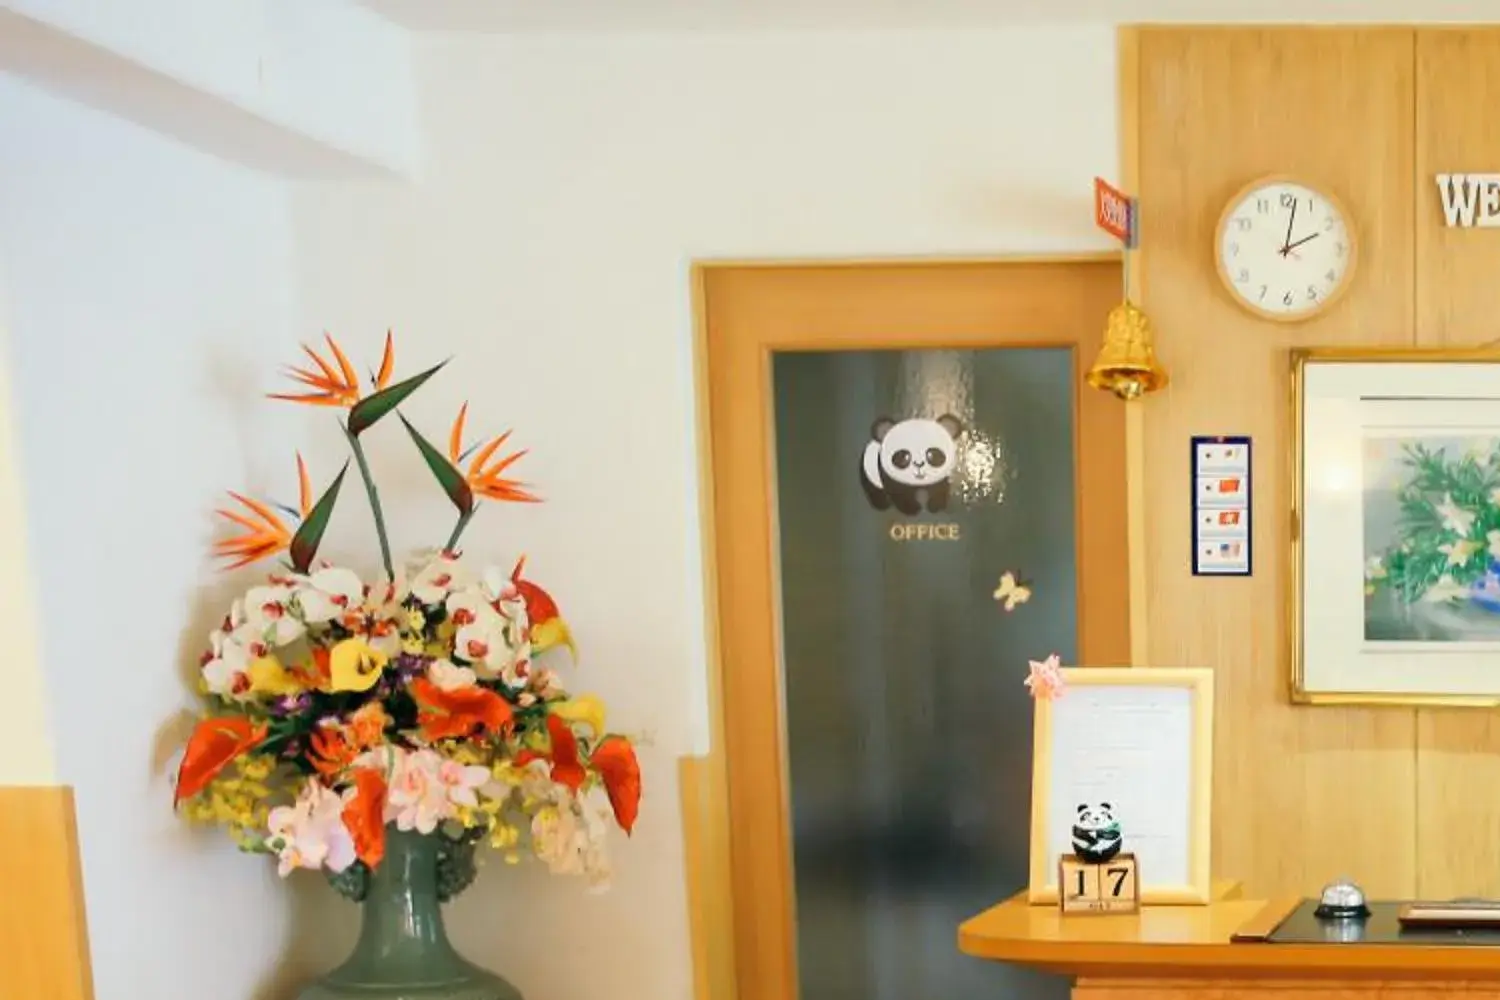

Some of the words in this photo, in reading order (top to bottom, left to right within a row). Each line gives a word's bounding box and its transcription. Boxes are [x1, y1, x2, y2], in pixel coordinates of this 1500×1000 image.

[1257, 198, 1269, 214] 11
[1280, 193, 1293, 208] 12
[1259, 285, 1268, 301] 7
[1282, 290, 1293, 306] 6
[1307, 284, 1318, 300] 5
[890, 523, 960, 541] OFFICE
